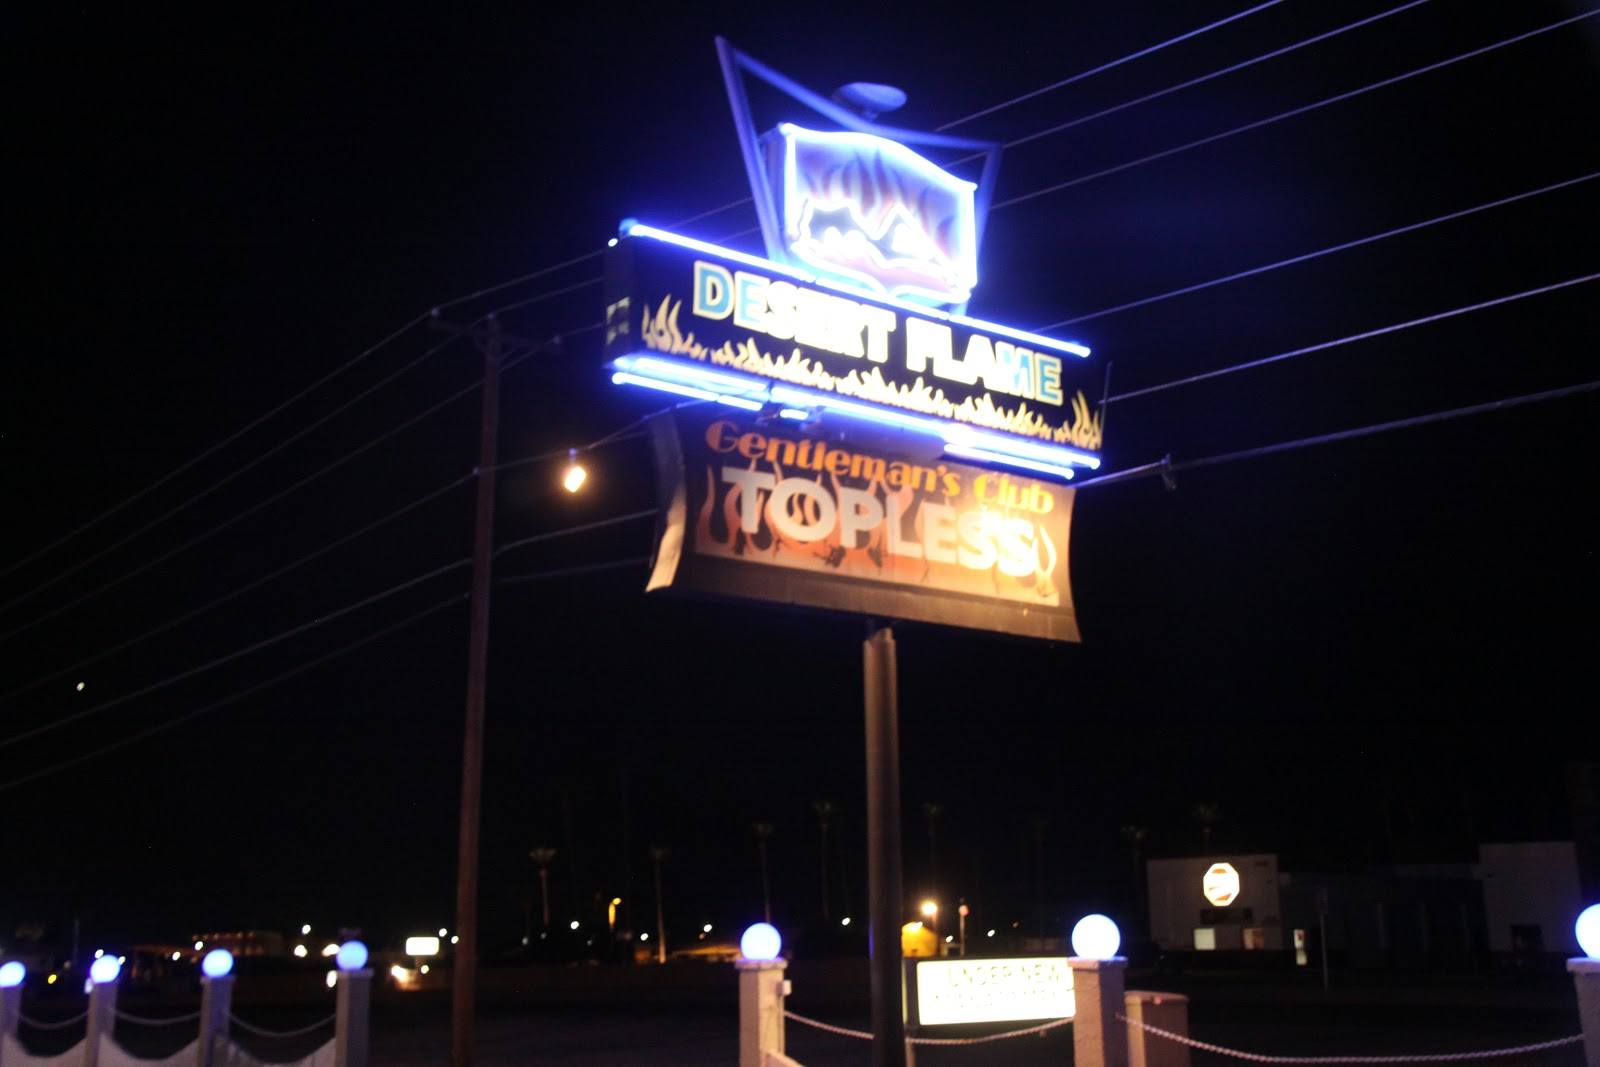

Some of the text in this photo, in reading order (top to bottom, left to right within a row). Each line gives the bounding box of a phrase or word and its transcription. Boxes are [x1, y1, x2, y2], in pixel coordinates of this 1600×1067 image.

[693, 261, 1063, 406] DESERT FLAME
[705, 421, 1055, 514] Gentleman's Club
[722, 466, 1037, 577] TOPLESS
